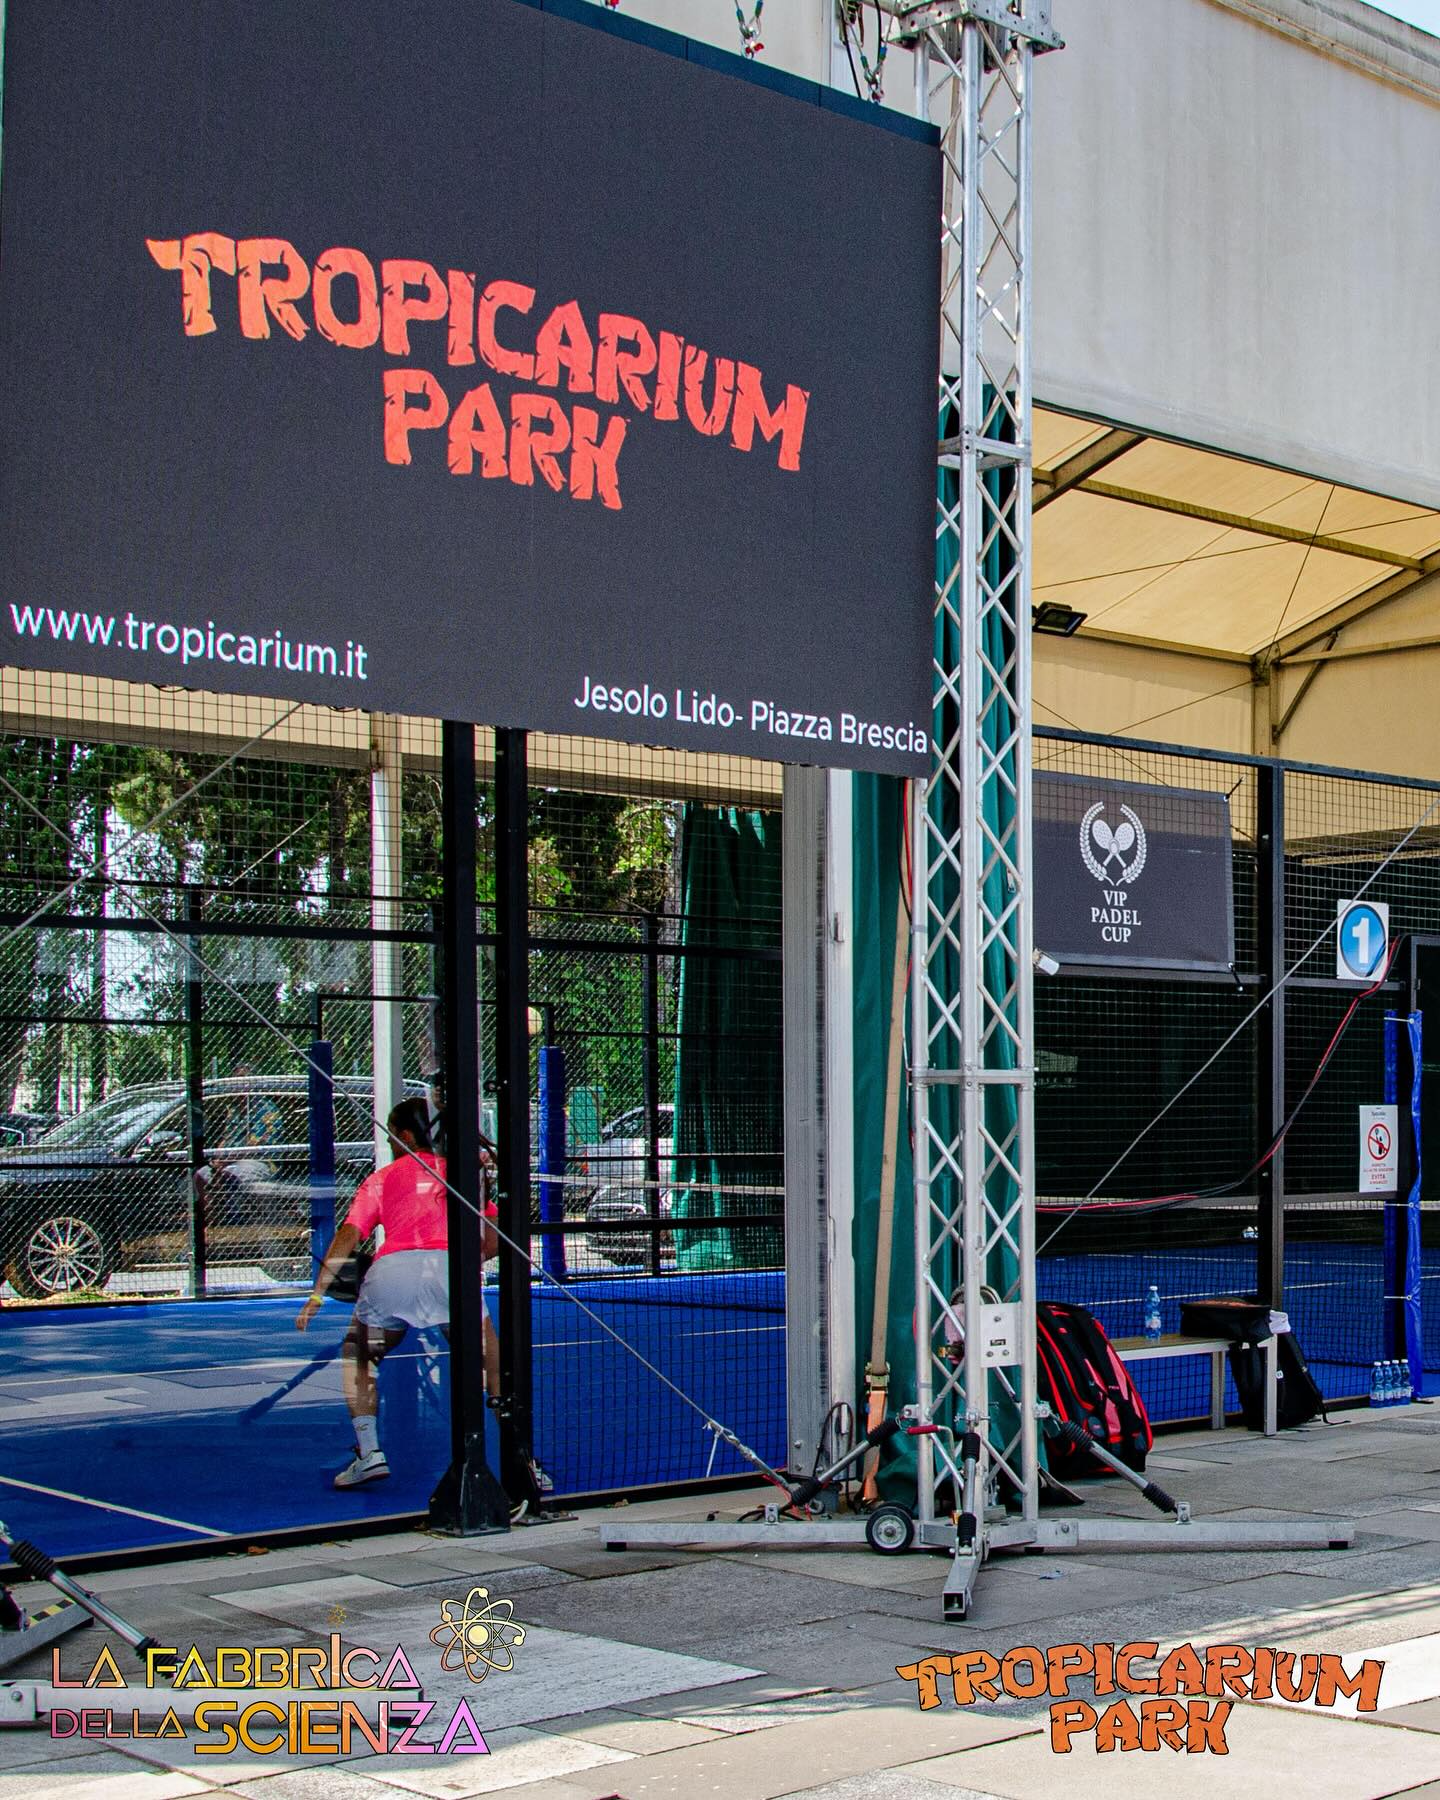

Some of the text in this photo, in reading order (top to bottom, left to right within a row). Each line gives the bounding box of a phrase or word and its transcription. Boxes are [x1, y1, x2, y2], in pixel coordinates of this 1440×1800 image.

[146, 232, 811, 472] TROPICARIUM
[382, 369, 628, 512] PARK
[9, 602, 368, 681] www.tropicarium.it
[574, 675, 929, 754] Jesolo Lido- Piazza Brescia
[1091, 906, 1141, 926] PADEL
[1102, 889, 1128, 907] VIP
[1101, 926, 1132, 943] CUP
[1352, 917, 1369, 964] 1
